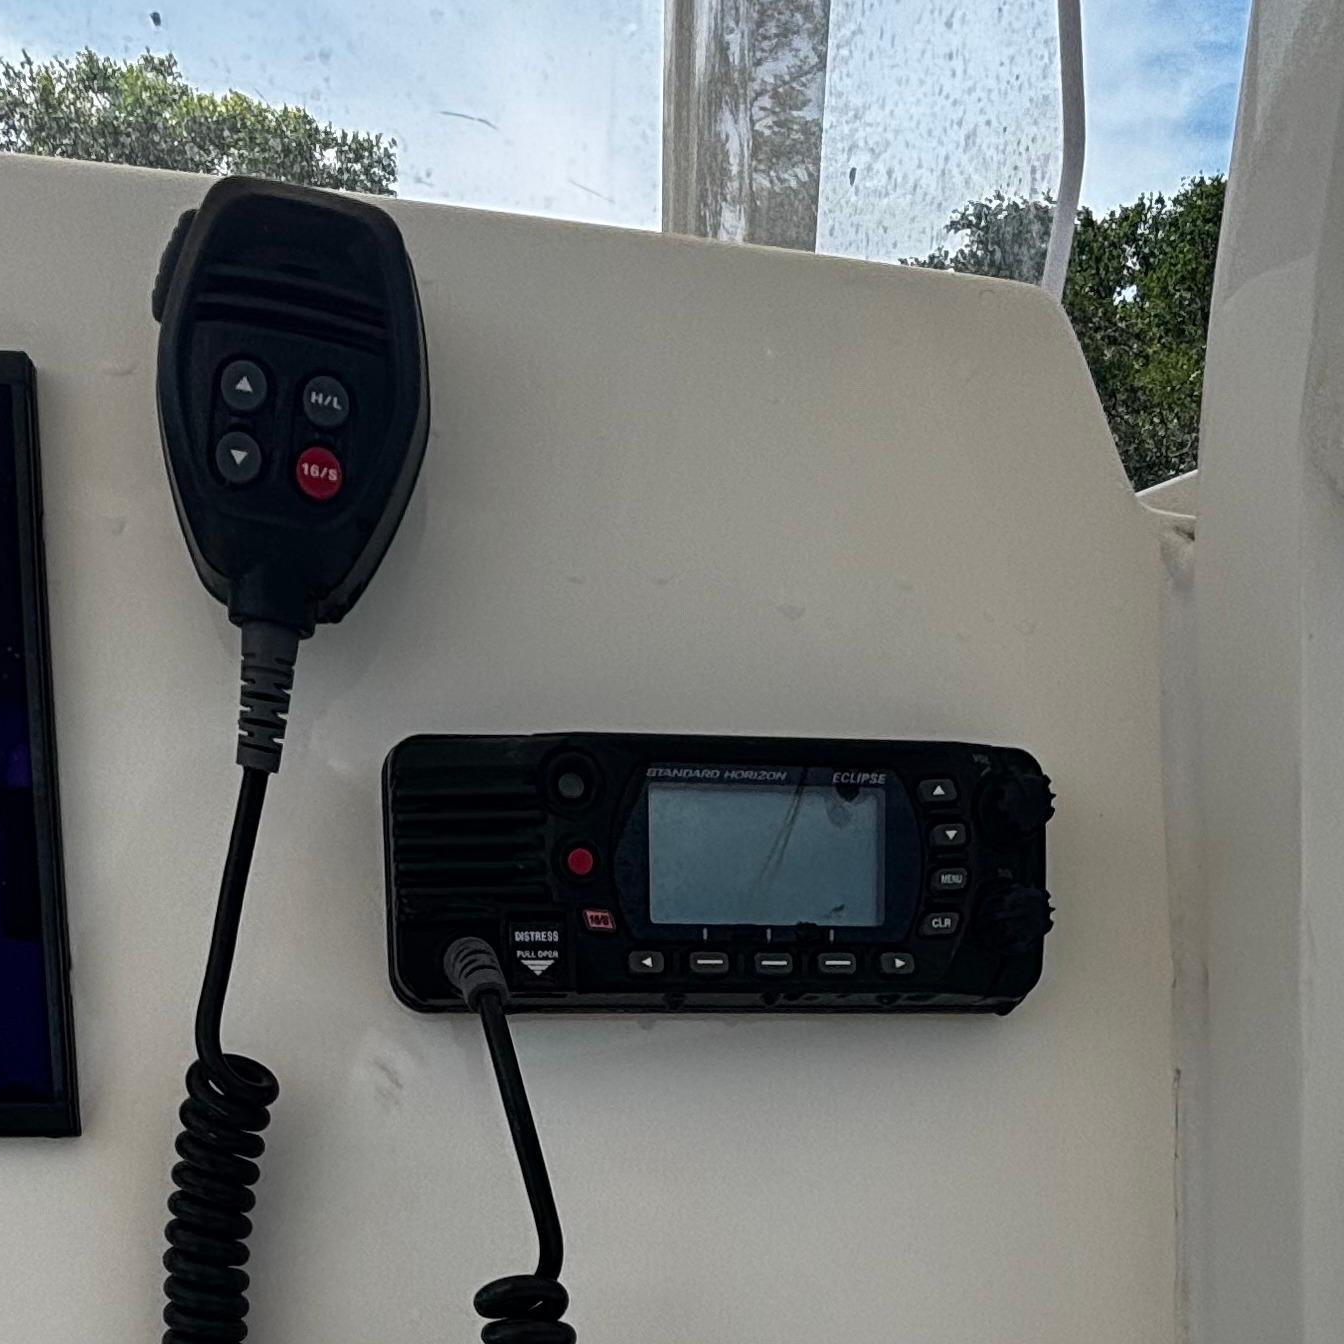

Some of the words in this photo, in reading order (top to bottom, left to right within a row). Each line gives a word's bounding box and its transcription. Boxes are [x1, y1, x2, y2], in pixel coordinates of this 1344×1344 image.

[311, 391, 342, 410] H/L
[302, 462, 338, 481] 16/S
[646, 767, 720, 779] STANDARD
[723, 769, 788, 782] HORIZON
[832, 771, 887, 785] ECLIPSE
[932, 917, 952, 928] CLR
[514, 930, 559, 942] DISTRESS
[516, 949, 536, 959] PULL
